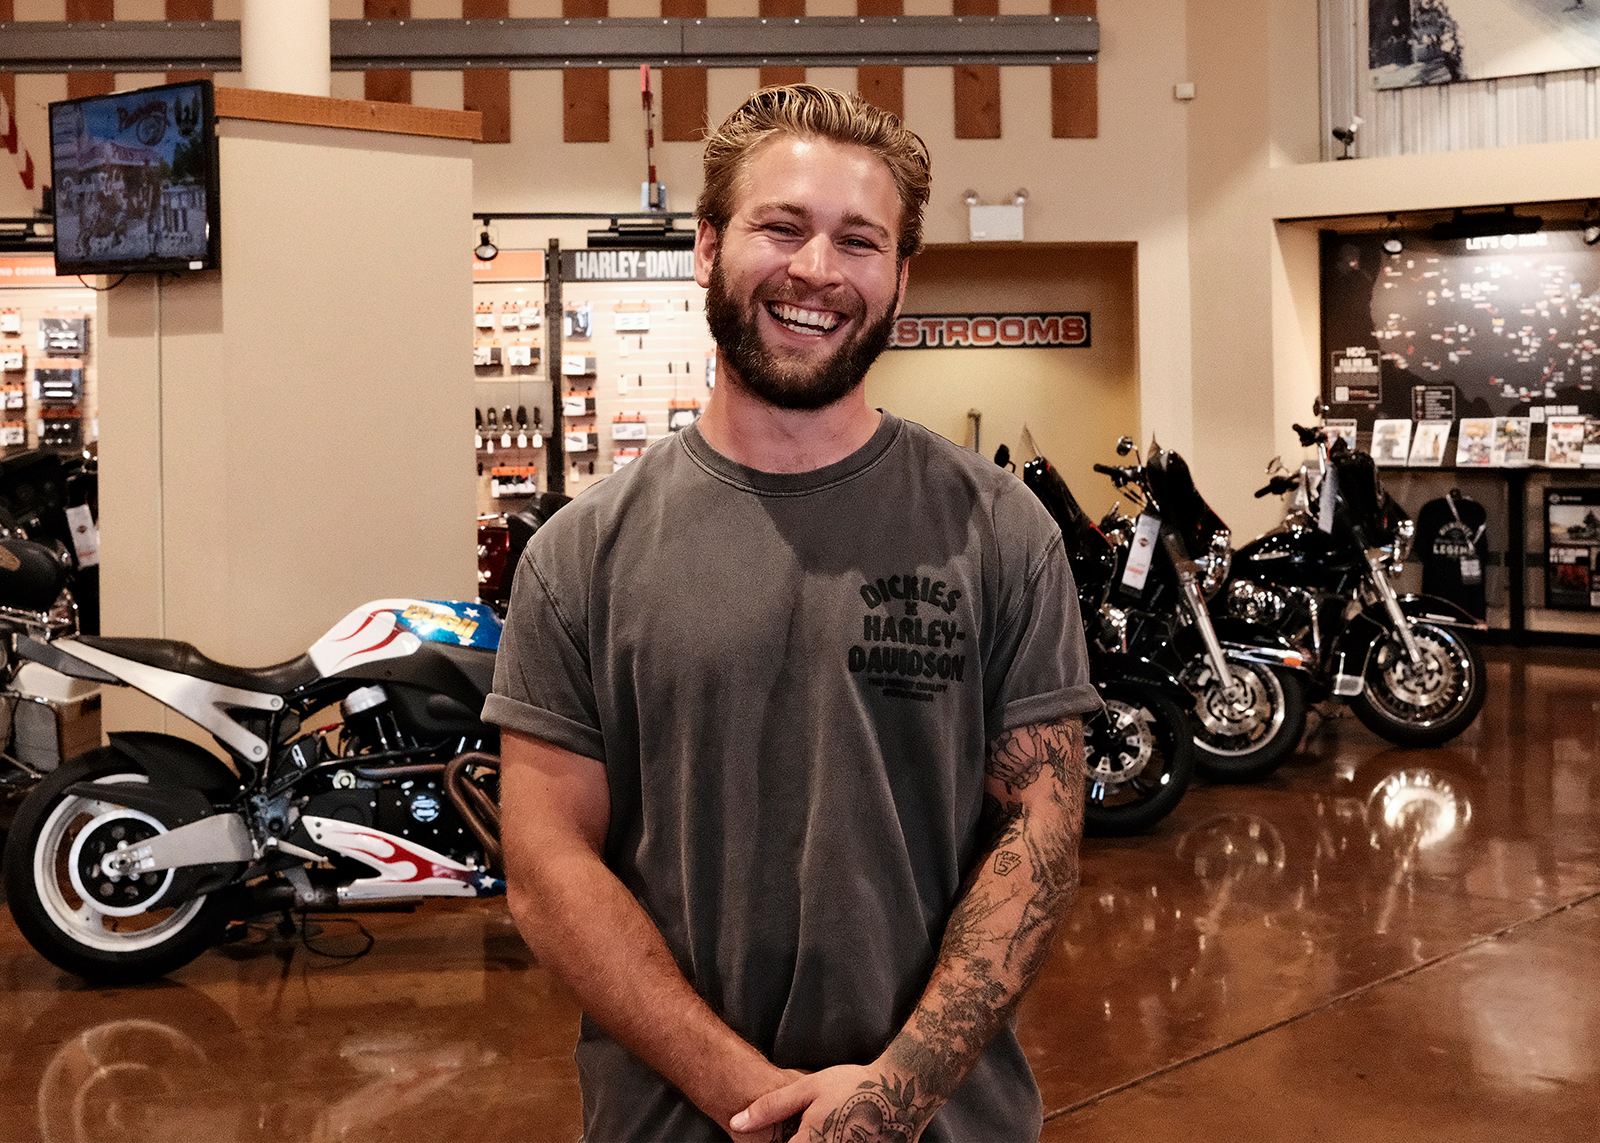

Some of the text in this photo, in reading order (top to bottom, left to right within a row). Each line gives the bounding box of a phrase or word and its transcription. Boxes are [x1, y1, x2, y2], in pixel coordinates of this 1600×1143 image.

[575, 251, 694, 279] HARLEY-DAVID
[890, 316, 1086, 346] STROOMS
[860, 575, 962, 615] DICKIES
[864, 615, 966, 649] HARLEY-
